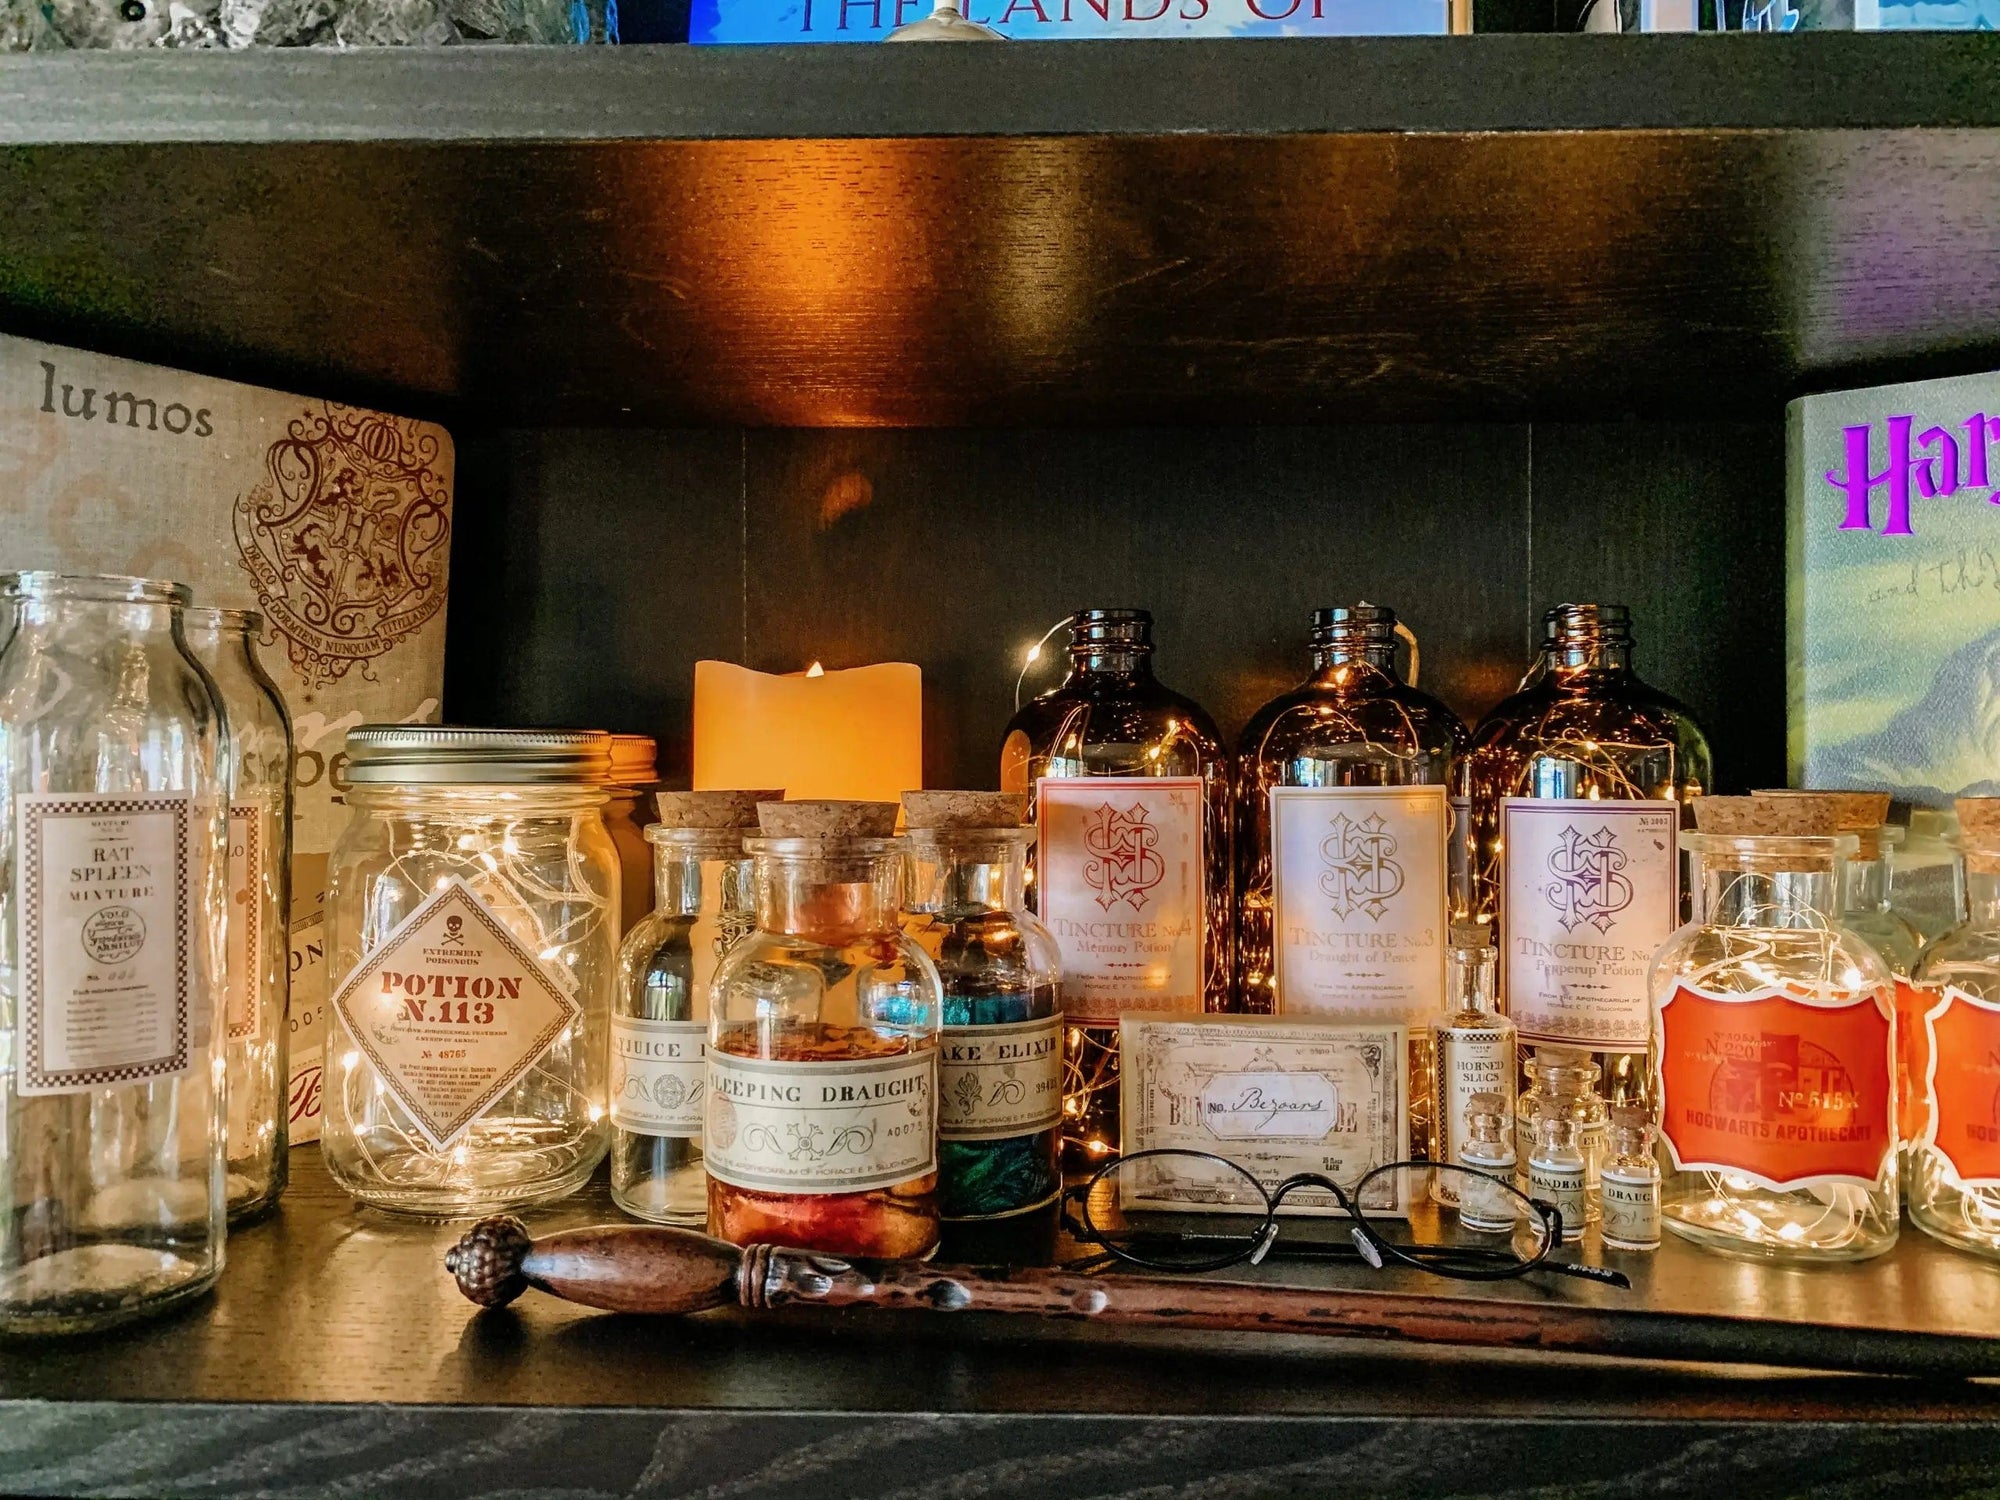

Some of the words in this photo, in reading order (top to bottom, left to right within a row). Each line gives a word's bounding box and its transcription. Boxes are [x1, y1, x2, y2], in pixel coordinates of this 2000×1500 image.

[39, 360, 214, 438] lumos
[244, 544, 277, 586] DRACO
[269, 601, 323, 649] DORMIENS
[325, 638, 381, 656] NUNQUAM
[93, 846, 135, 863] RAT
[70, 865, 153, 882] SPLEEN
[69, 887, 154, 901] MIXTURE
[1053, 918, 1156, 938] TINCTURE
[1290, 927, 1397, 949] TINCTURE
[423, 948, 484, 957] EXTREMELY
[1135, 941, 1172, 953] Potion
[1517, 937, 1626, 961] TINCTURE
[425, 957, 480, 966] POISONOUS
[1365, 951, 1378, 963] of
[1602, 963, 1644, 977] Potion
[381, 971, 523, 1000] POTION
[402, 998, 495, 1025] N.113
[438, 1050, 467, 1060] 48765
[998, 1037, 1057, 1060] ELIXIR
[1456, 1060, 1504, 1072] HORNED
[1463, 1073, 1500, 1082] SLUGS
[709, 1072, 801, 1103] SLEEPING
[822, 1074, 925, 1103] DRAUGHT
[1459, 1085, 1505, 1094] MIXTURE
[1231, 1087, 1323, 1131] Bezoars
[1686, 1109, 1771, 1138] HOGWARTS
[1775, 1123, 1872, 1142] APOTHECARY
[800, 1167, 813, 1176] OF
[815, 1166, 857, 1176] HORACE
